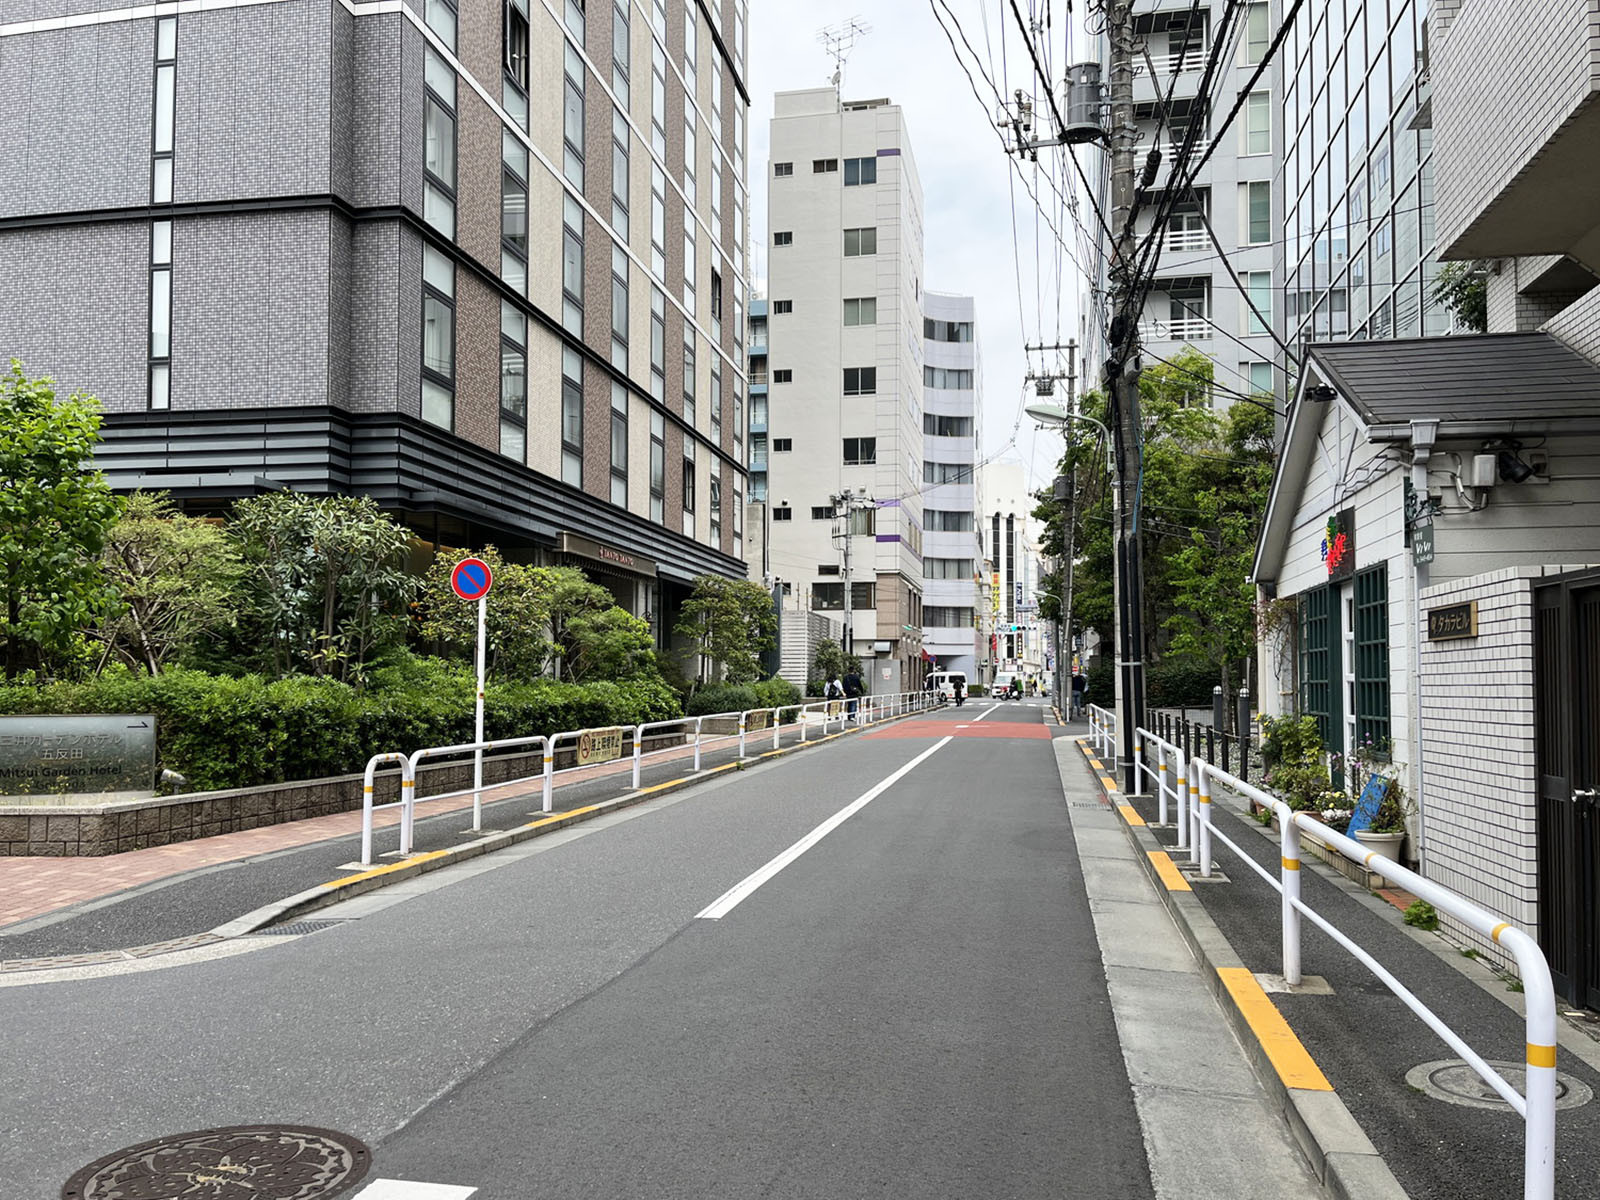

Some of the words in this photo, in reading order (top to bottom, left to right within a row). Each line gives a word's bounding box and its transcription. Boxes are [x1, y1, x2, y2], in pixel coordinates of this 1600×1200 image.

[41, 748, 84, 760] 五反田
[0, 767, 38, 779] Mitsui
[41, 766, 87, 777] Garden
[90, 764, 122, 775] Hotel
